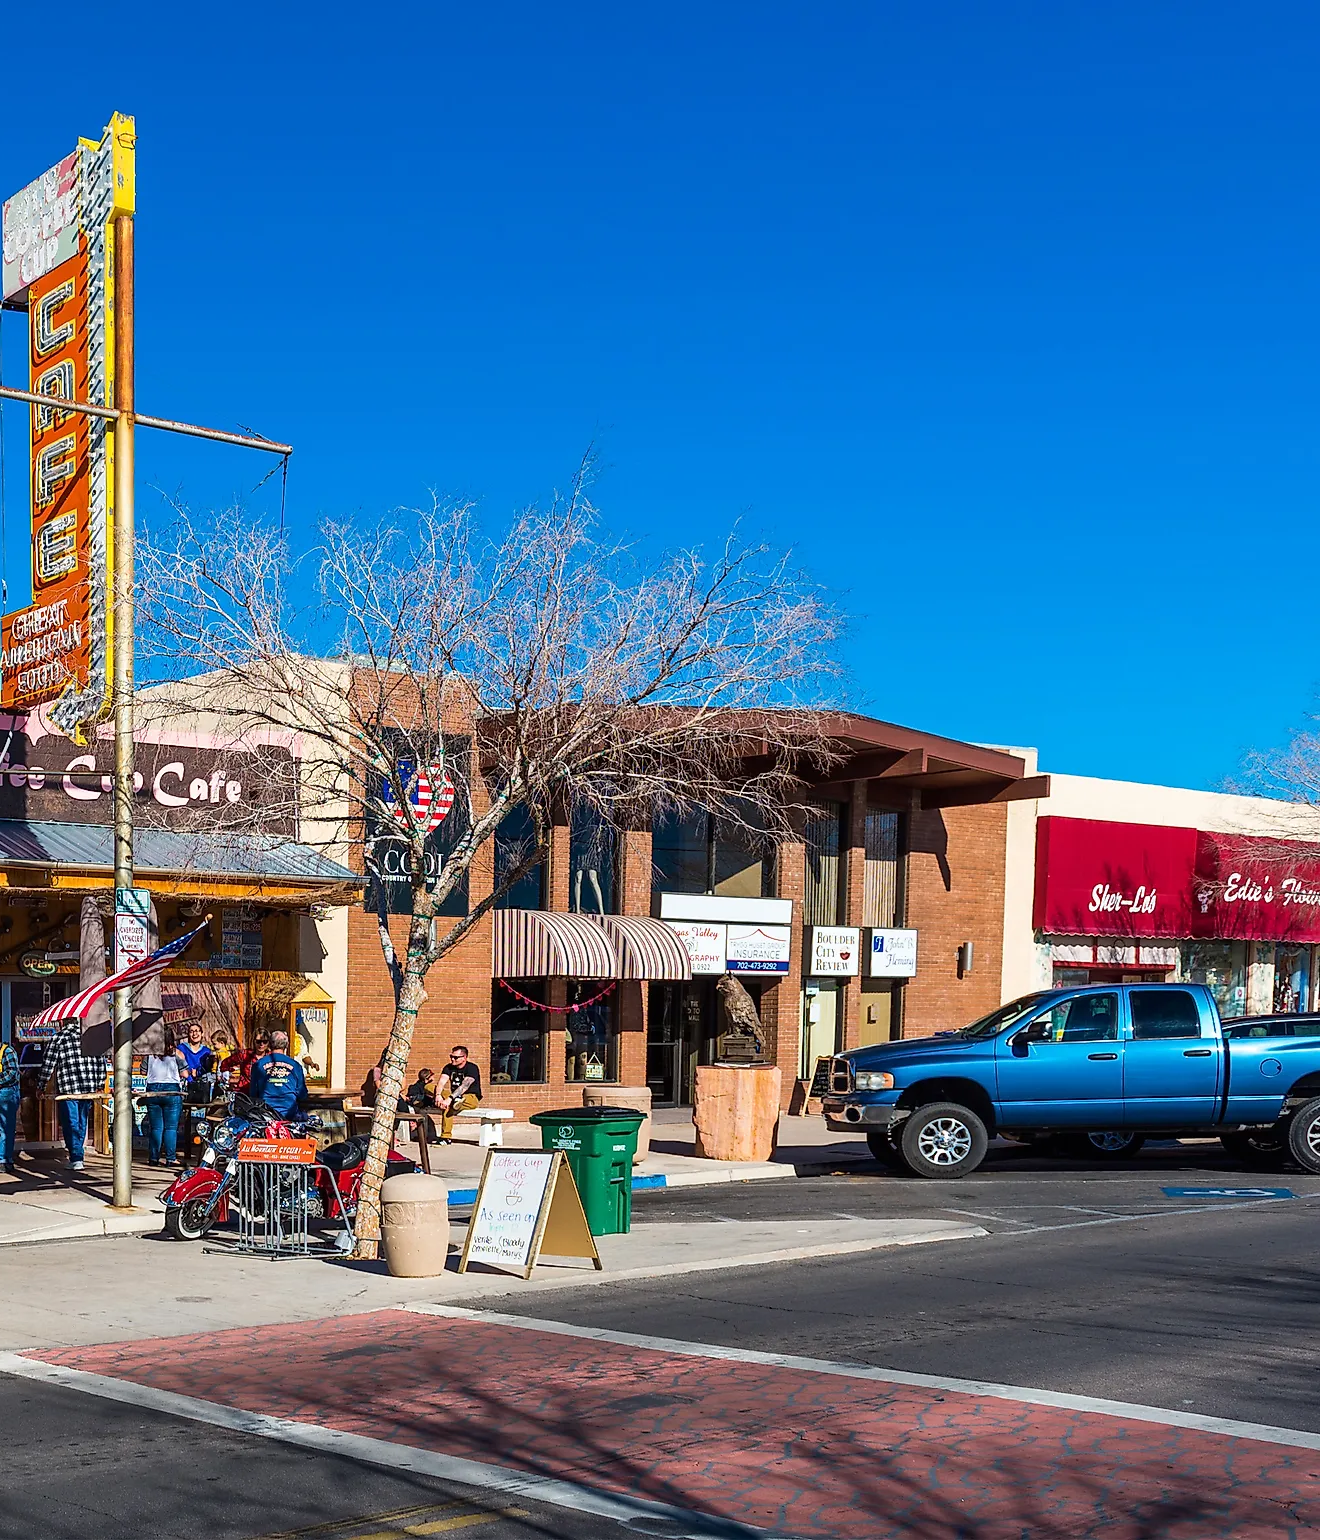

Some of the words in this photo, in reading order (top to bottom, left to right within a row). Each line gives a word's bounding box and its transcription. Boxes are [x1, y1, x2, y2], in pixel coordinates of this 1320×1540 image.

[34, 276, 78, 581] CAFE
[153, 762, 242, 807] Cafe
[1223, 872, 1274, 903] Edie's
[691, 926, 718, 940] Valley
[733, 949, 781, 960] INSURANCE
[885, 953, 914, 969] Fleming
[23, 958, 52, 969] OPEN
[737, 962, 778, 970] 702-473-9292
[493, 1156, 521, 1167] Coffee
[524, 1158, 543, 1171] Cup
[504, 1169, 526, 1180] Cafe
[480, 1208, 494, 1222] As
[497, 1210, 521, 1222] seen
[524, 1212, 535, 1223] on
